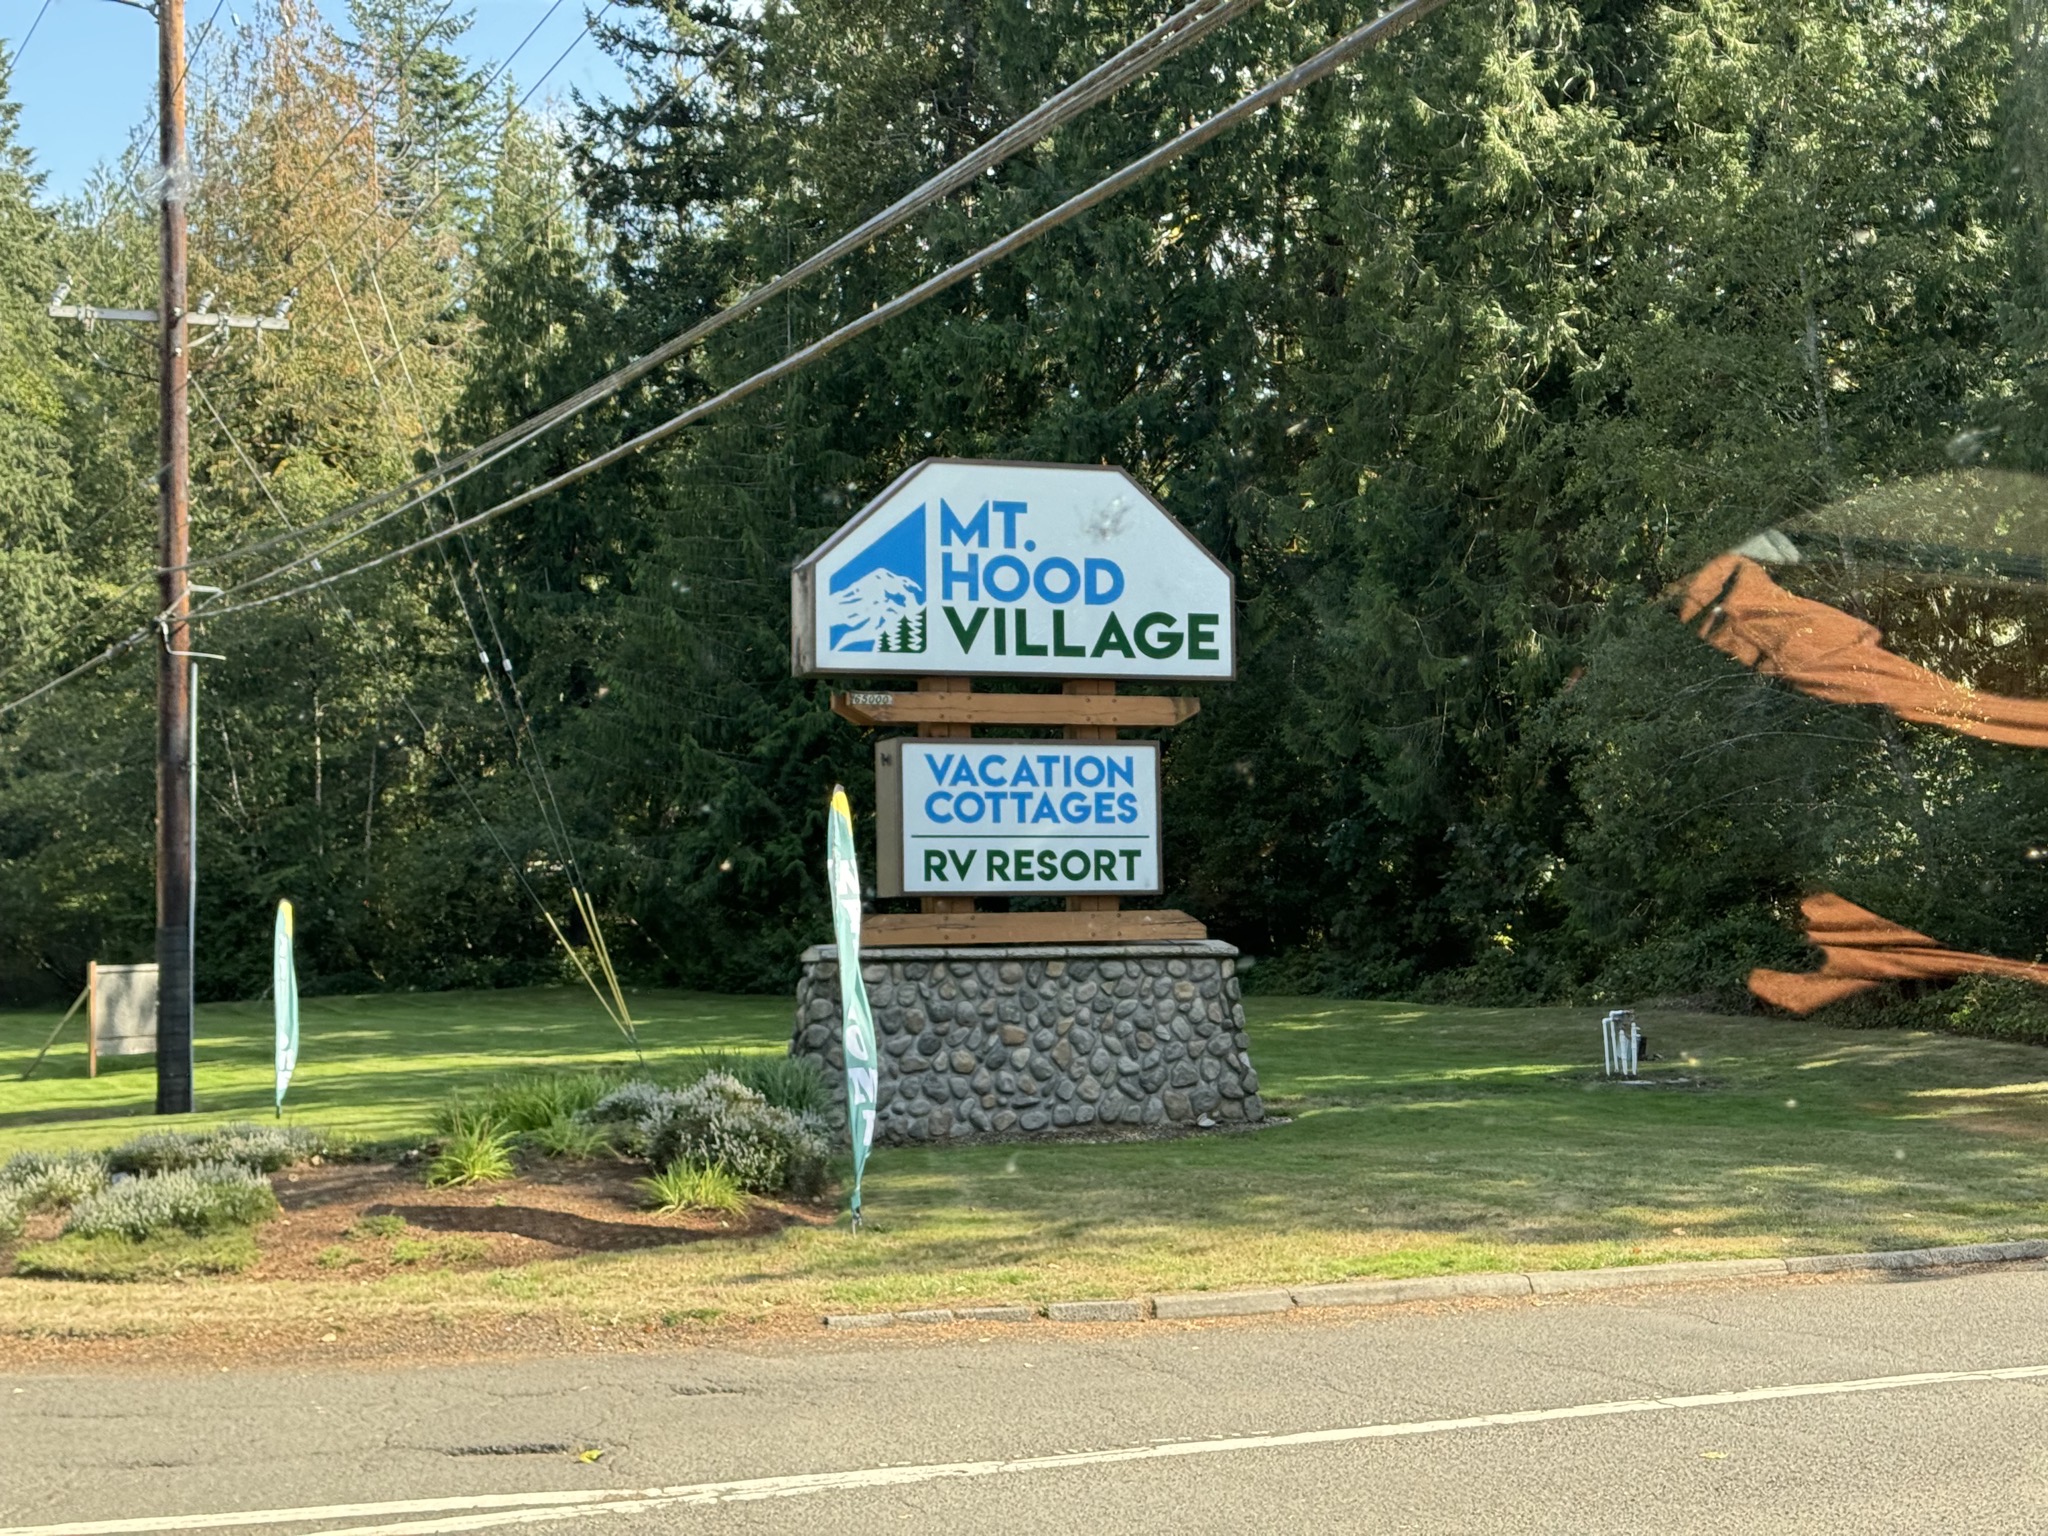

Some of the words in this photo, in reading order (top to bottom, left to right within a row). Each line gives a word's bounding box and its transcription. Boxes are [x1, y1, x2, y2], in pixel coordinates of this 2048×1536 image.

[940, 498, 1036, 552] MT.
[942, 552, 1125, 605] HOOD
[942, 606, 1219, 660] VILLAGE
[924, 754, 1133, 788] VACATION
[924, 790, 1138, 824] COTTAGES
[924, 849, 977, 882] RV
[986, 849, 1141, 881] RESORT
